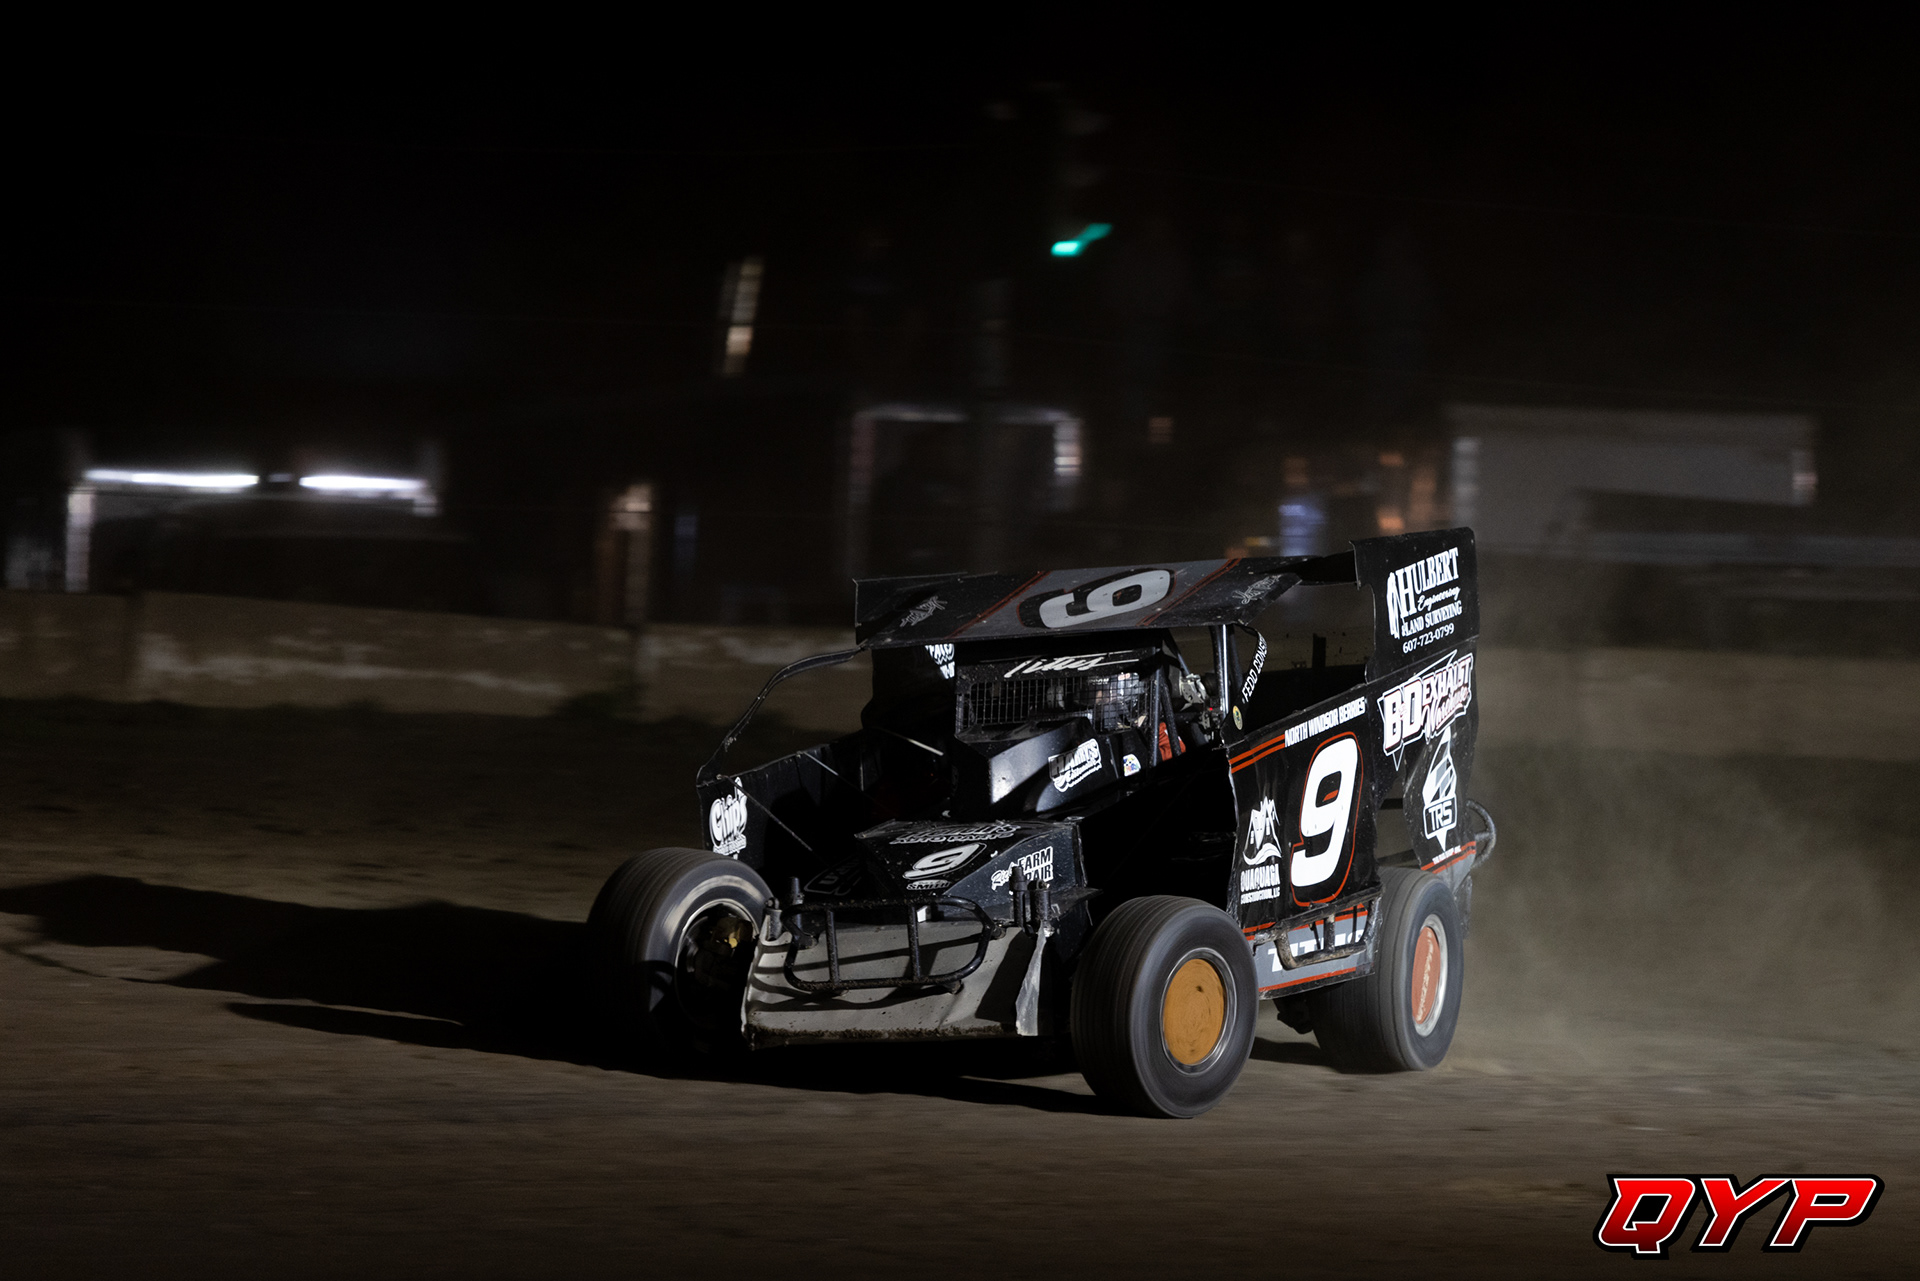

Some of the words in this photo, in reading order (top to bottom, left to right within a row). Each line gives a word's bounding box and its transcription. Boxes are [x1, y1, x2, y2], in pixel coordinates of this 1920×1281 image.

[1039, 569, 1170, 628] 9
[1395, 547, 1459, 618] HULBERT
[1424, 600, 1463, 628] SURVEYING
[1402, 622, 1455, 654] 607-723-0799
[1284, 721, 1308, 748] NORTH
[1307, 708, 1339, 738] WINDSOR
[1338, 696, 1366, 724] BERRIES
[1291, 738, 1358, 887] 9
[1428, 800, 1453, 831] TRS
[902, 843, 982, 880] 9
